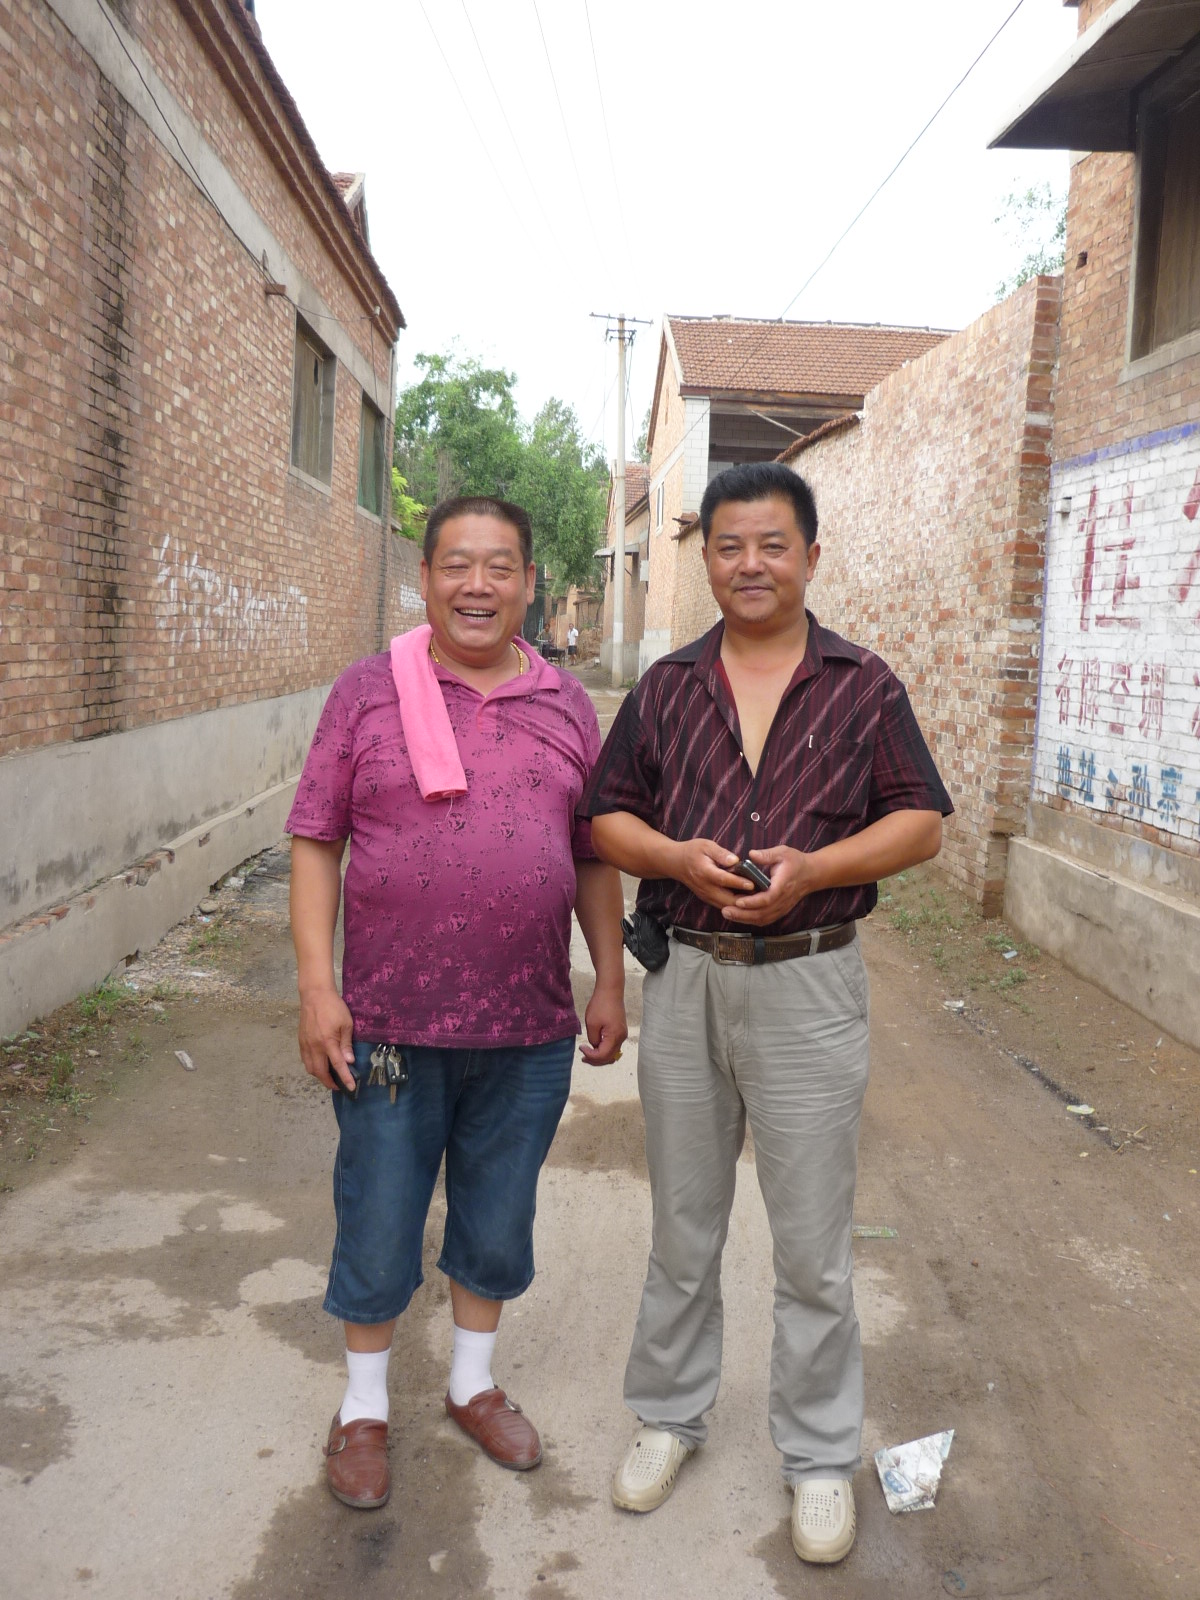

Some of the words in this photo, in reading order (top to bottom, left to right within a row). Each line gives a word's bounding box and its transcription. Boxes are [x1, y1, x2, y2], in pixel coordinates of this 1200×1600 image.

[1055, 653, 1200, 741] 名牌空调
[1057, 744, 1200, 840] 地址：孙寨
